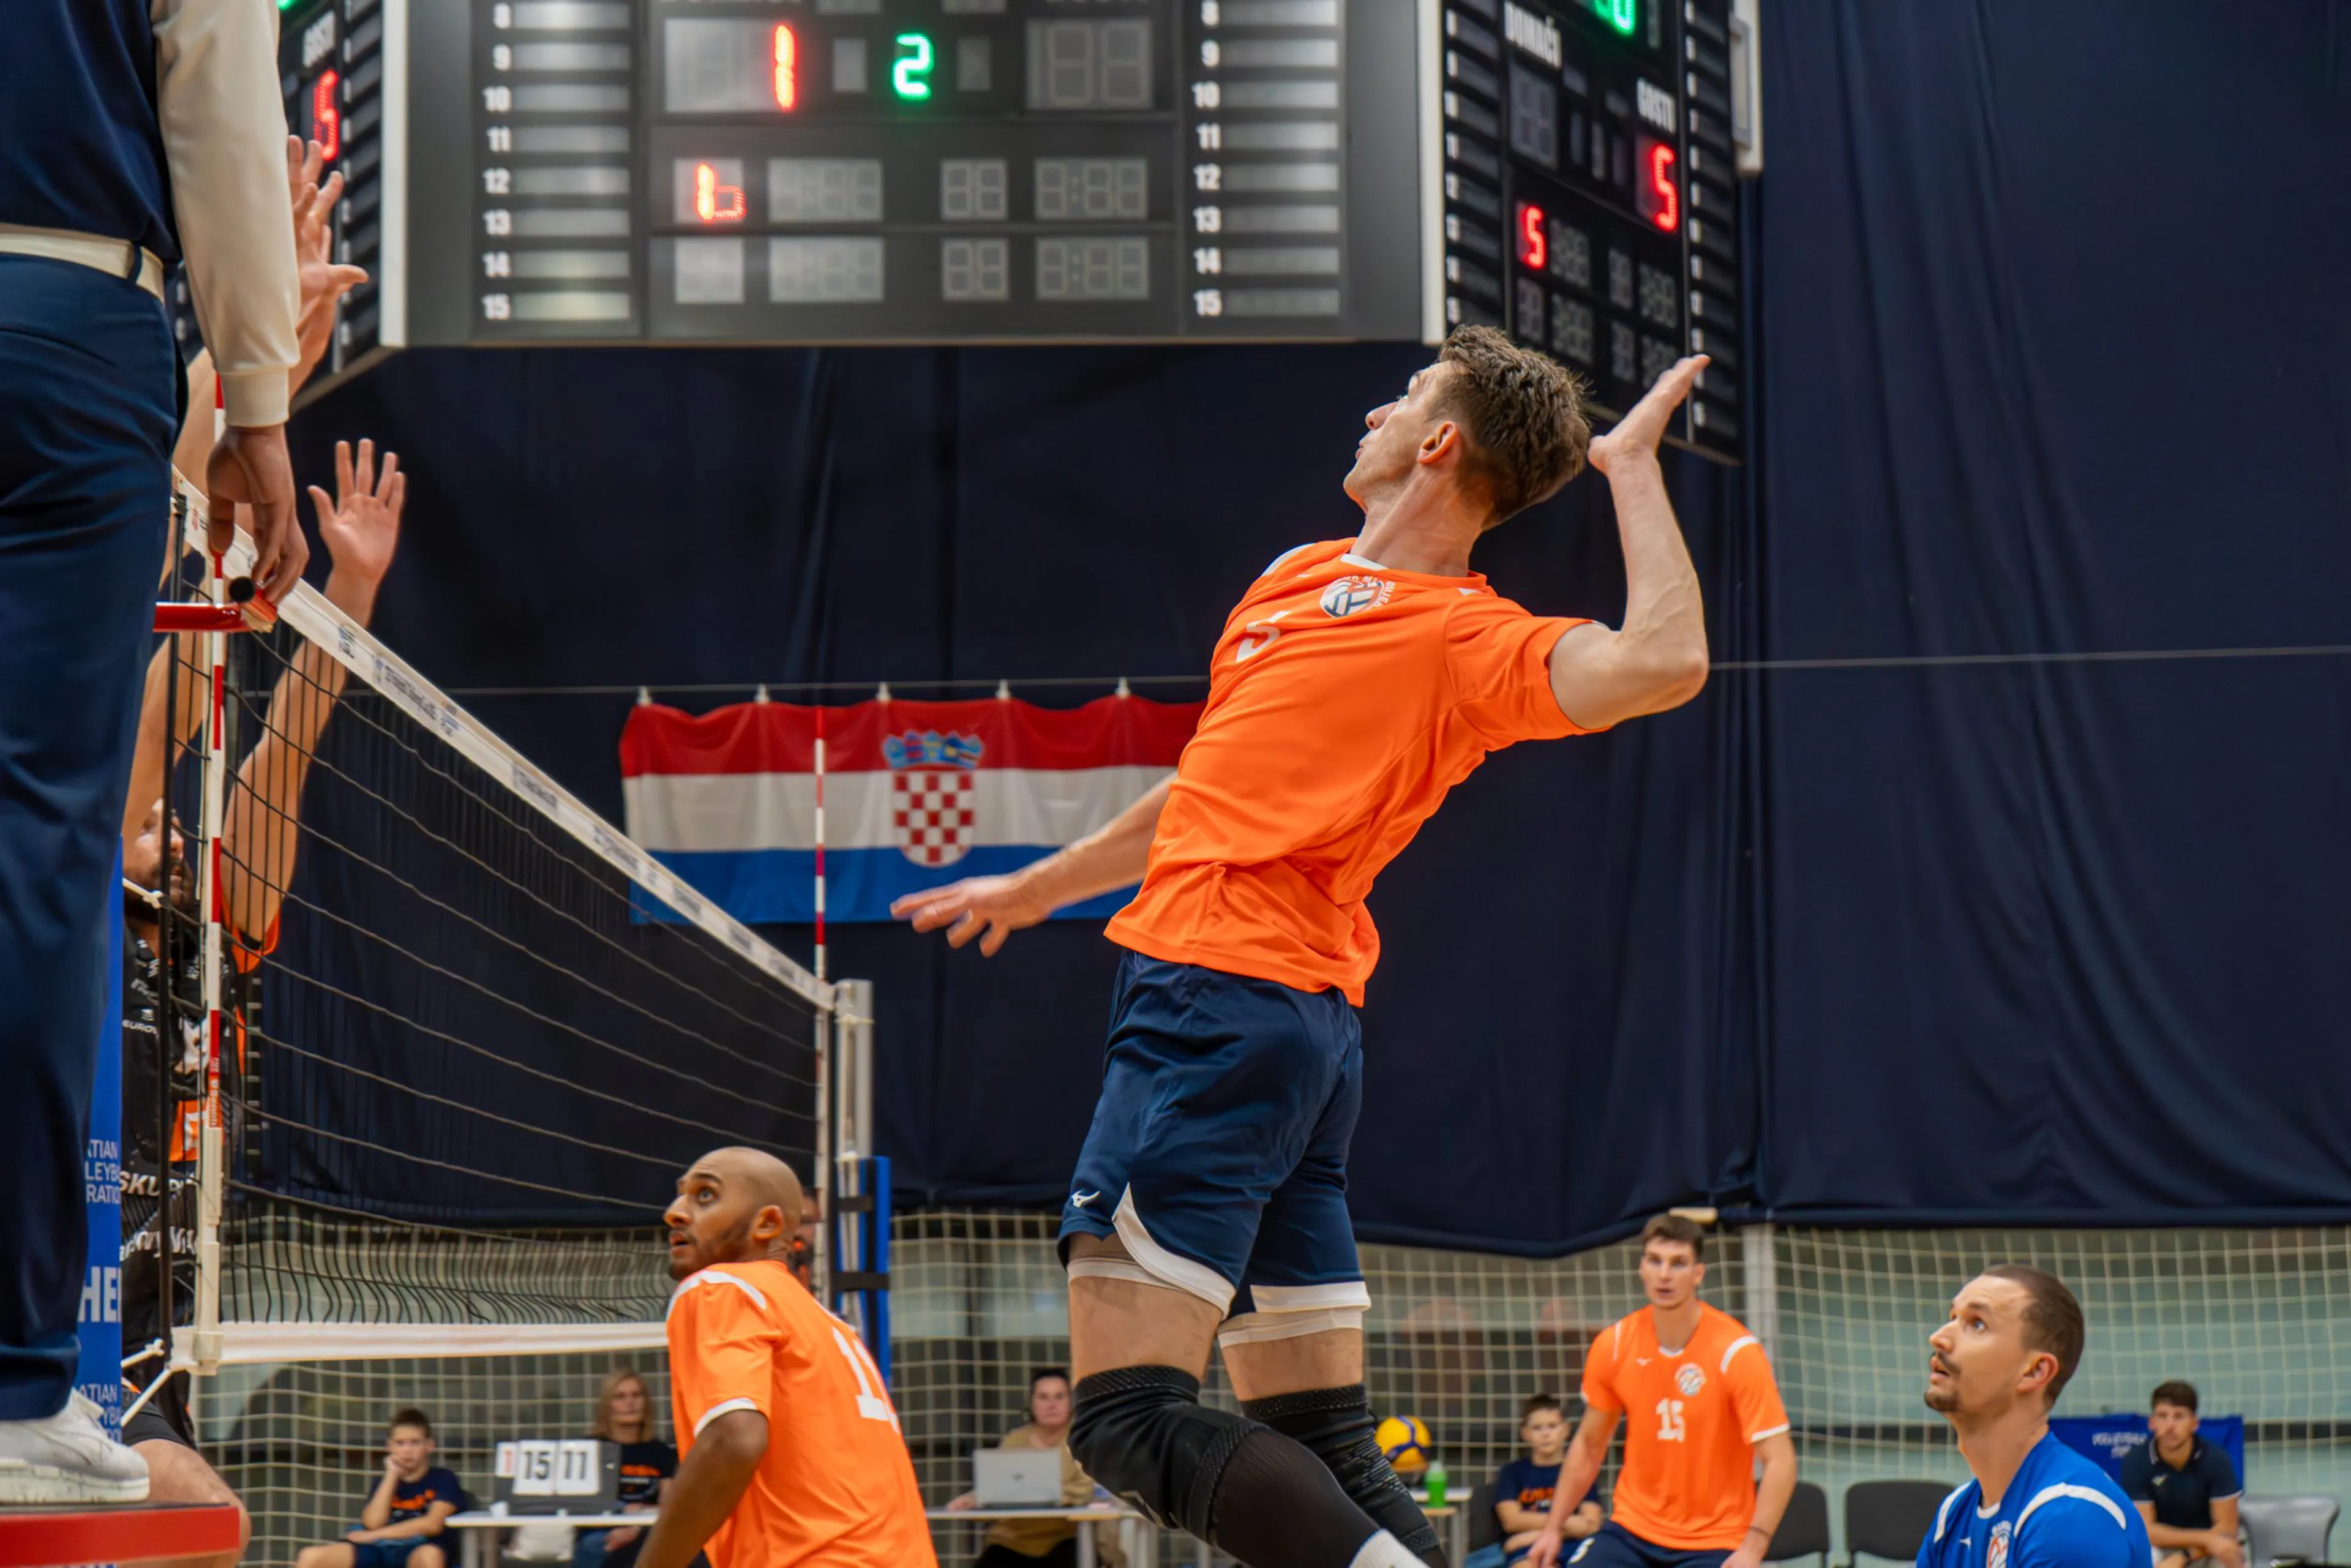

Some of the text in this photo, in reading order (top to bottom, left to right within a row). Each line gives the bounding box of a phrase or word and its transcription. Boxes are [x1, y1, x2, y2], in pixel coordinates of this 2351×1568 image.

[492, 44, 511, 72] 9
[771, 23, 797, 112] 1
[892, 33, 935, 100] 2
[1201, 39, 1220, 68] 9
[481, 85, 511, 112] 10
[1191, 81, 1220, 109] 10
[486, 126, 511, 152] 11
[1196, 123, 1220, 150] 11
[482, 167, 510, 195] 12
[1193, 162, 1221, 191] 12
[1653, 144, 1677, 232] 5
[482, 209, 511, 236] 13
[1193, 205, 1222, 233] 13
[1521, 205, 1545, 269] 5
[482, 252, 511, 278] 14
[1193, 247, 1222, 274] 14
[481, 293, 511, 321] 15
[1193, 290, 1223, 318] 15
[1655, 1397, 1685, 1442] 15
[523, 1450, 551, 1480] 15
[562, 1450, 587, 1480] 11
